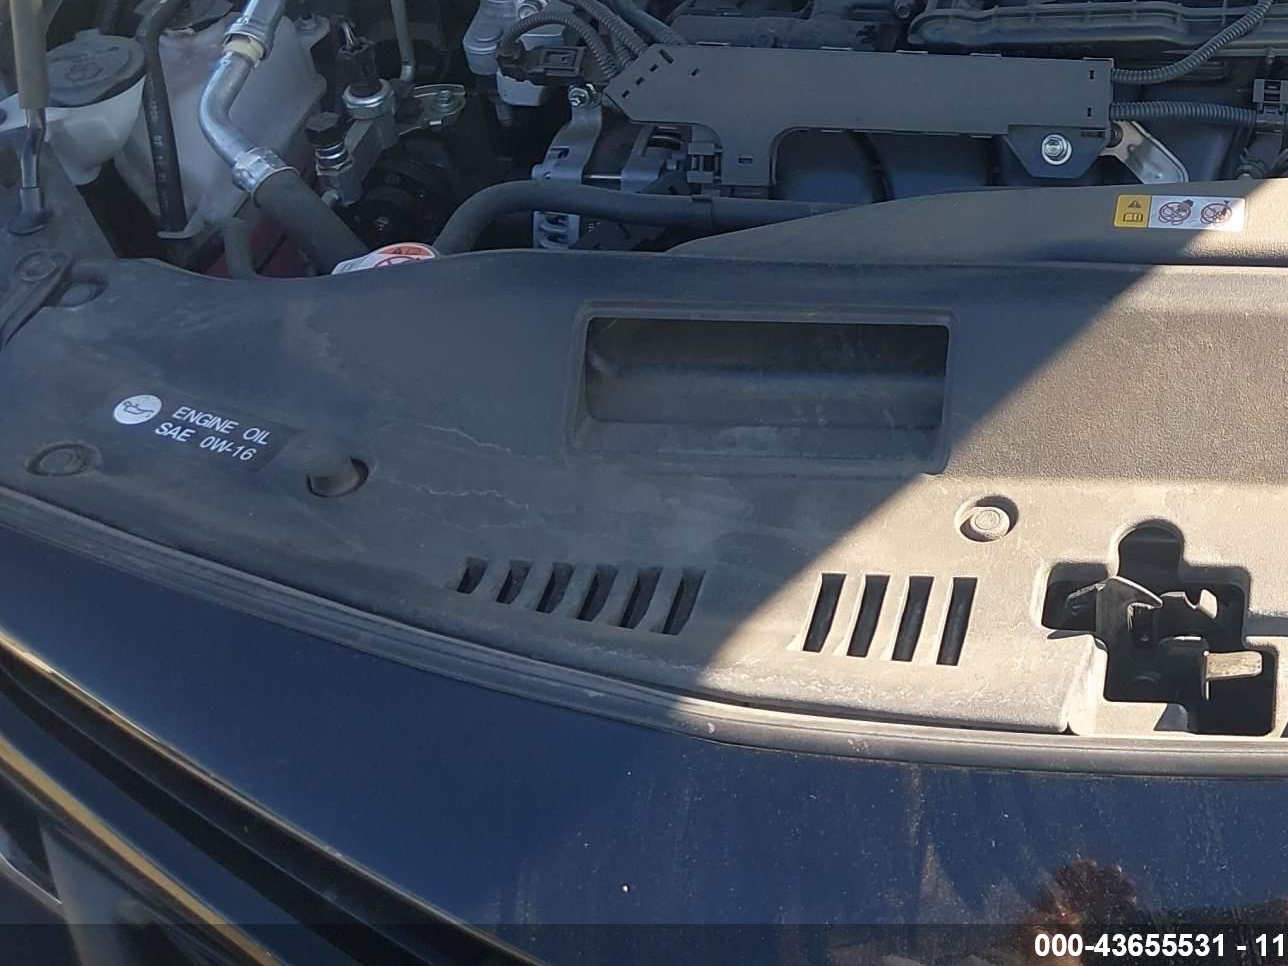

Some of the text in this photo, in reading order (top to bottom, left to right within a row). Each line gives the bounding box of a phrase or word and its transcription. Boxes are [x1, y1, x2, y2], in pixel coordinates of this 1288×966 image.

[155, 422, 257, 461] SAE 0W-16
[171, 406, 271, 445] ENGINE OIL
